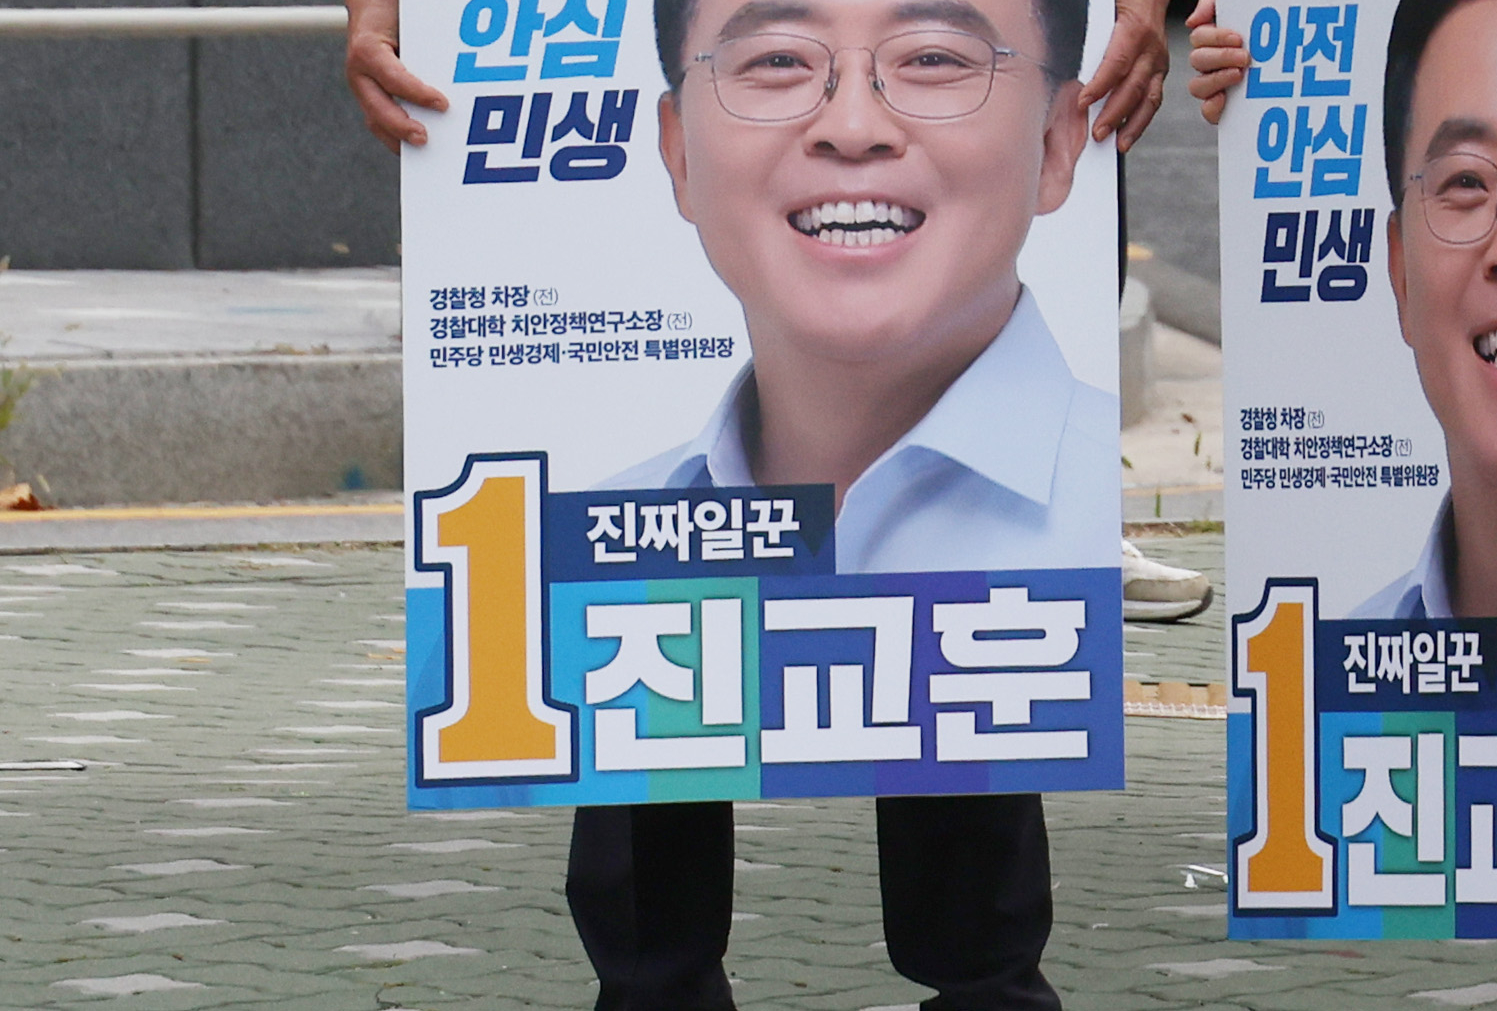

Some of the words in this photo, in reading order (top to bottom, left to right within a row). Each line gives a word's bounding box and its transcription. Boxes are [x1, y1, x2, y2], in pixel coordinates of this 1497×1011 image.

[1245, 3, 1359, 99] 안전
[462, 89, 639, 185] 민생
[1253, 103, 1368, 200] 안심
[1260, 207, 1375, 304] 민생
[429, 287, 486, 311] 경찰청
[429, 314, 506, 340] 경찰대학
[429, 345, 484, 368] 민주당
[643, 337, 735, 360] 특별위원장
[1240, 407, 1277, 431] 경찰청
[1240, 436, 1291, 460] 경찰대학
[1241, 467, 1277, 490] 민주당
[1380, 464, 1440, 487] 특별위원장
[586, 497, 800, 564] 진짜일꾼
[414, 450, 580, 789] 1
[585, 586, 1092, 772] 진교훈
[1342, 630, 1483, 695] 진짜일꾼
[1231, 577, 1338, 917] 1
